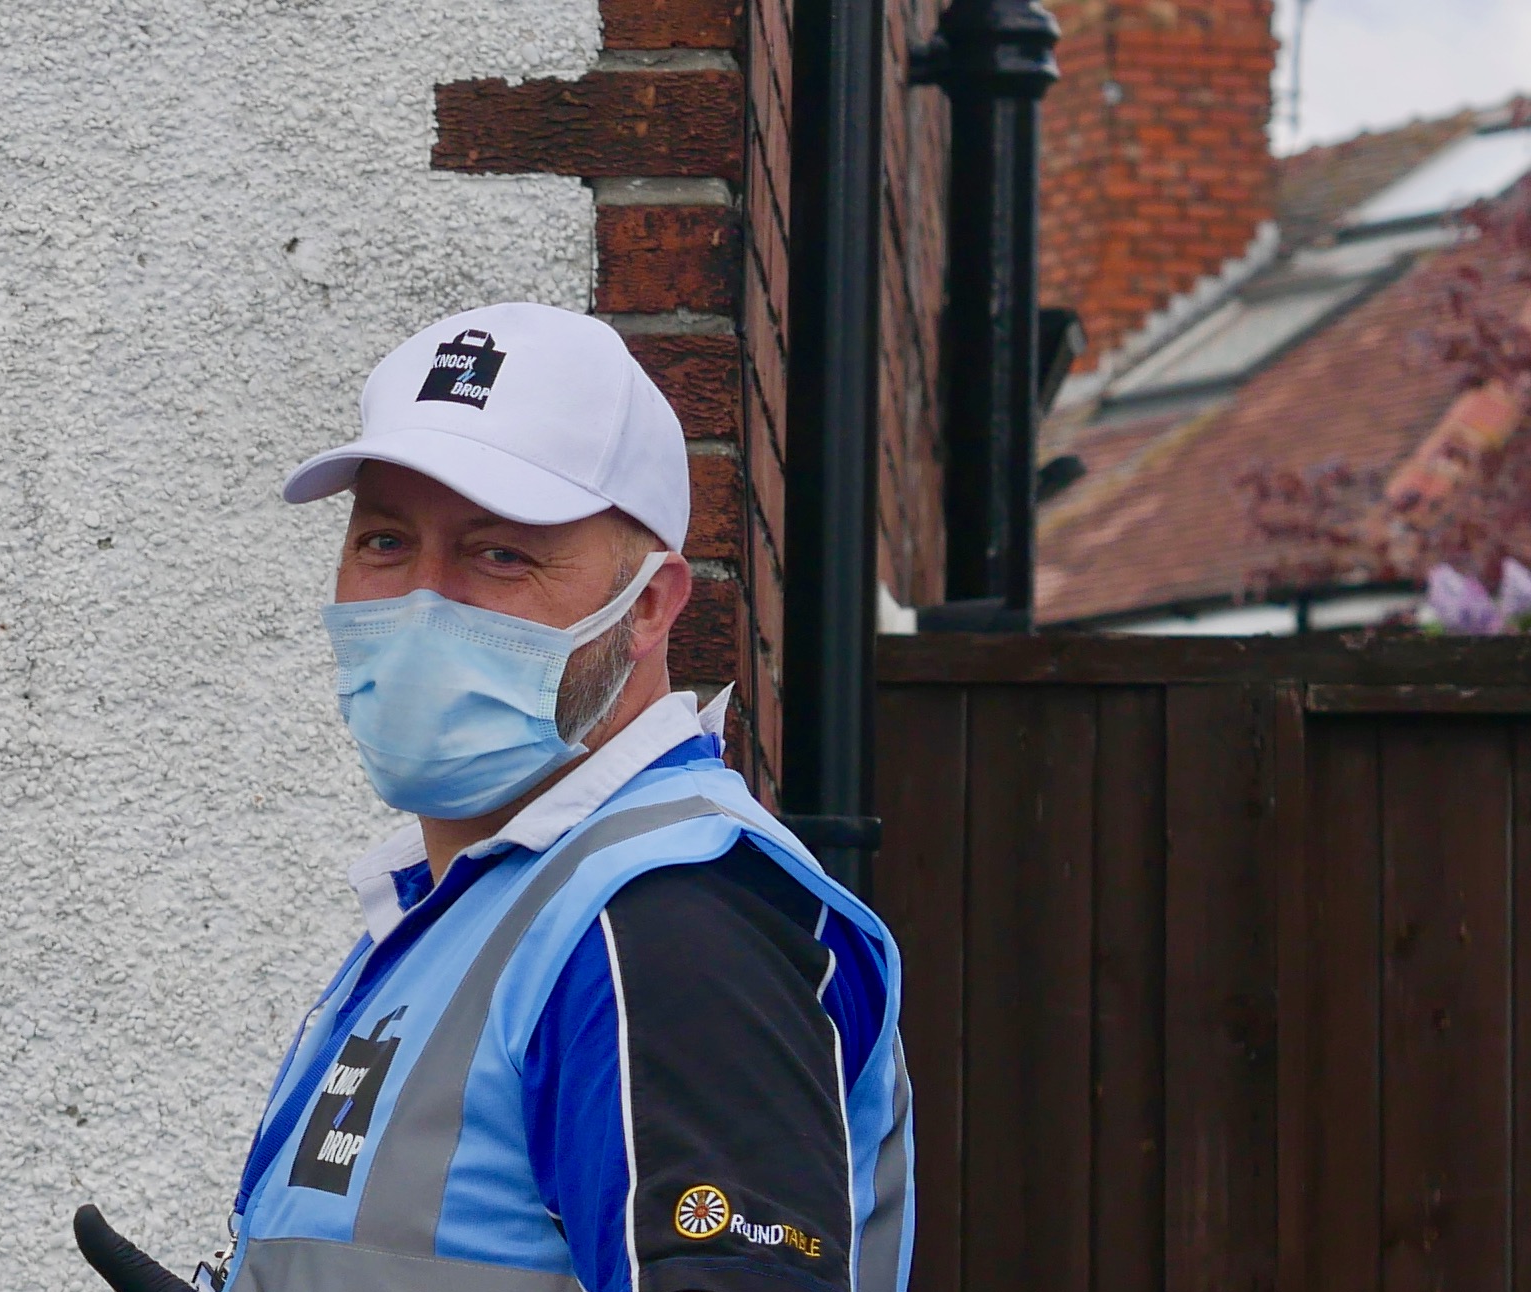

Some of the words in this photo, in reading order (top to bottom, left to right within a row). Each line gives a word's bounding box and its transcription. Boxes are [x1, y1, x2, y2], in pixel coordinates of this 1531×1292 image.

[433, 354, 477, 370] KNOCK
[450, 381, 492, 401] DROP
[315, 1128, 366, 1167] DROP
